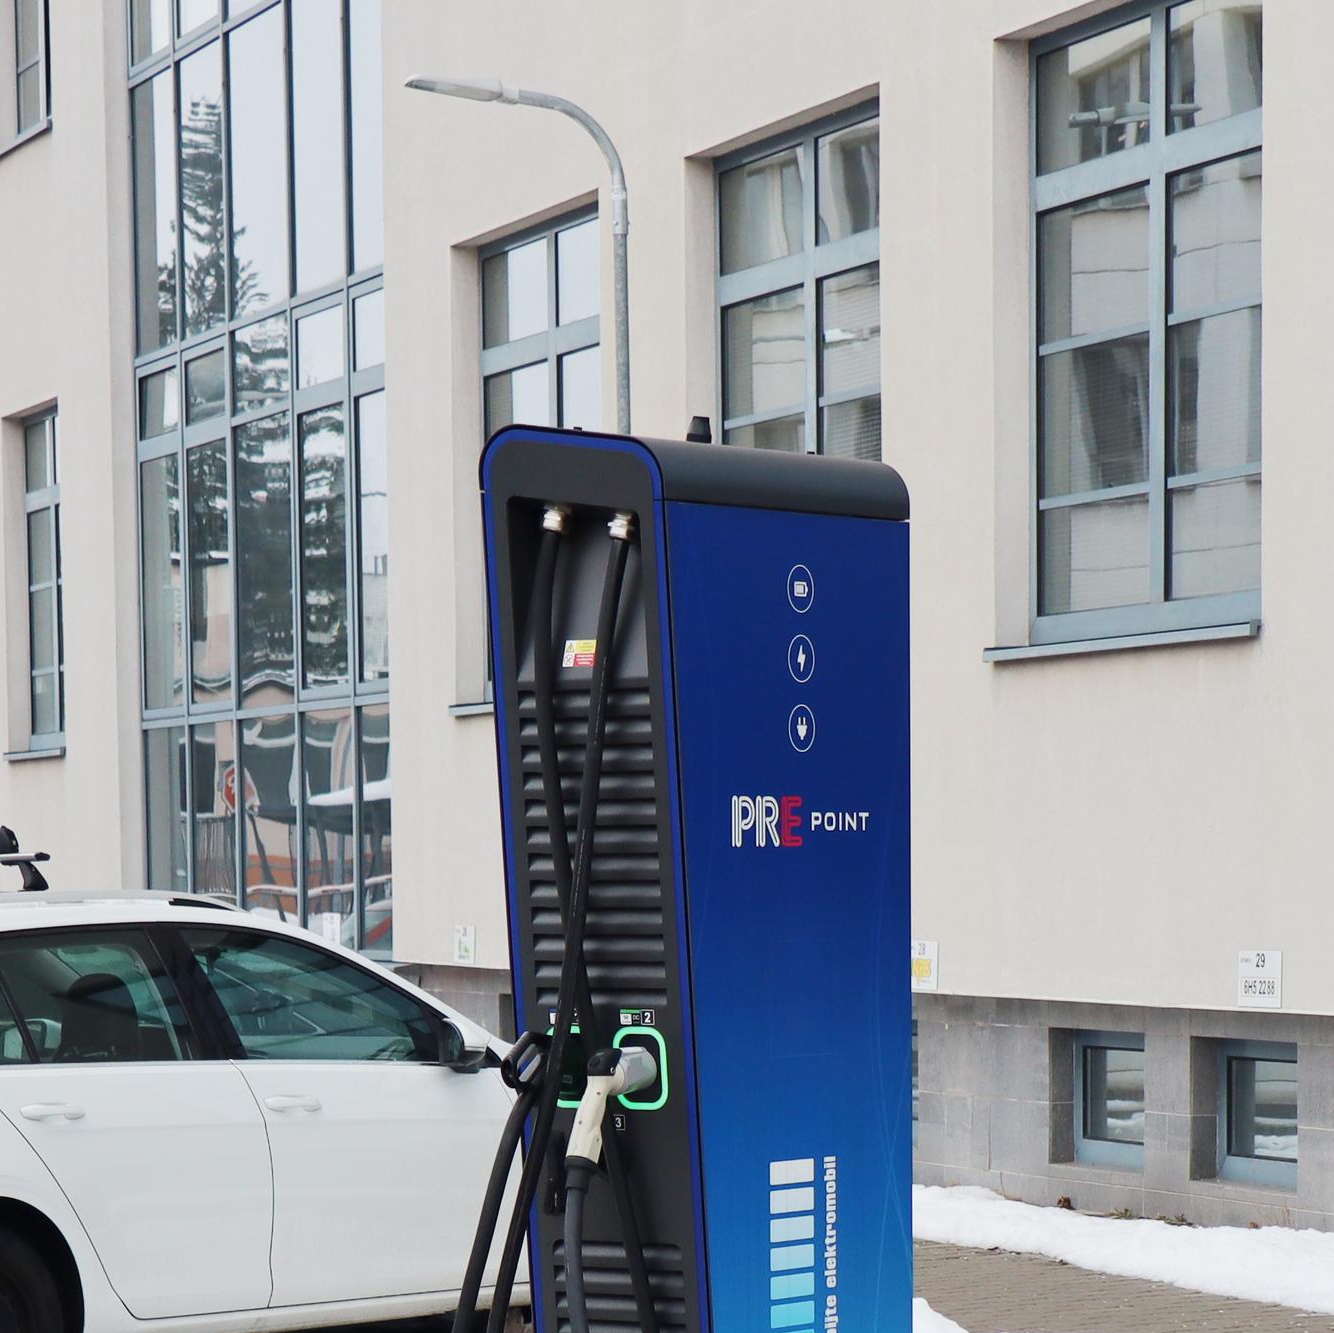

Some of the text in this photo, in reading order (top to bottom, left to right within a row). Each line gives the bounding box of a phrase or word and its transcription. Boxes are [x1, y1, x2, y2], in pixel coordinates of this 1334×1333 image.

[731, 795, 871, 848] PRE POINT
[1255, 952, 1266, 968] 29
[644, 1012, 651, 1023] 2
[615, 1117, 622, 1128] 3
[823, 1155, 837, 1289] elektromobil
